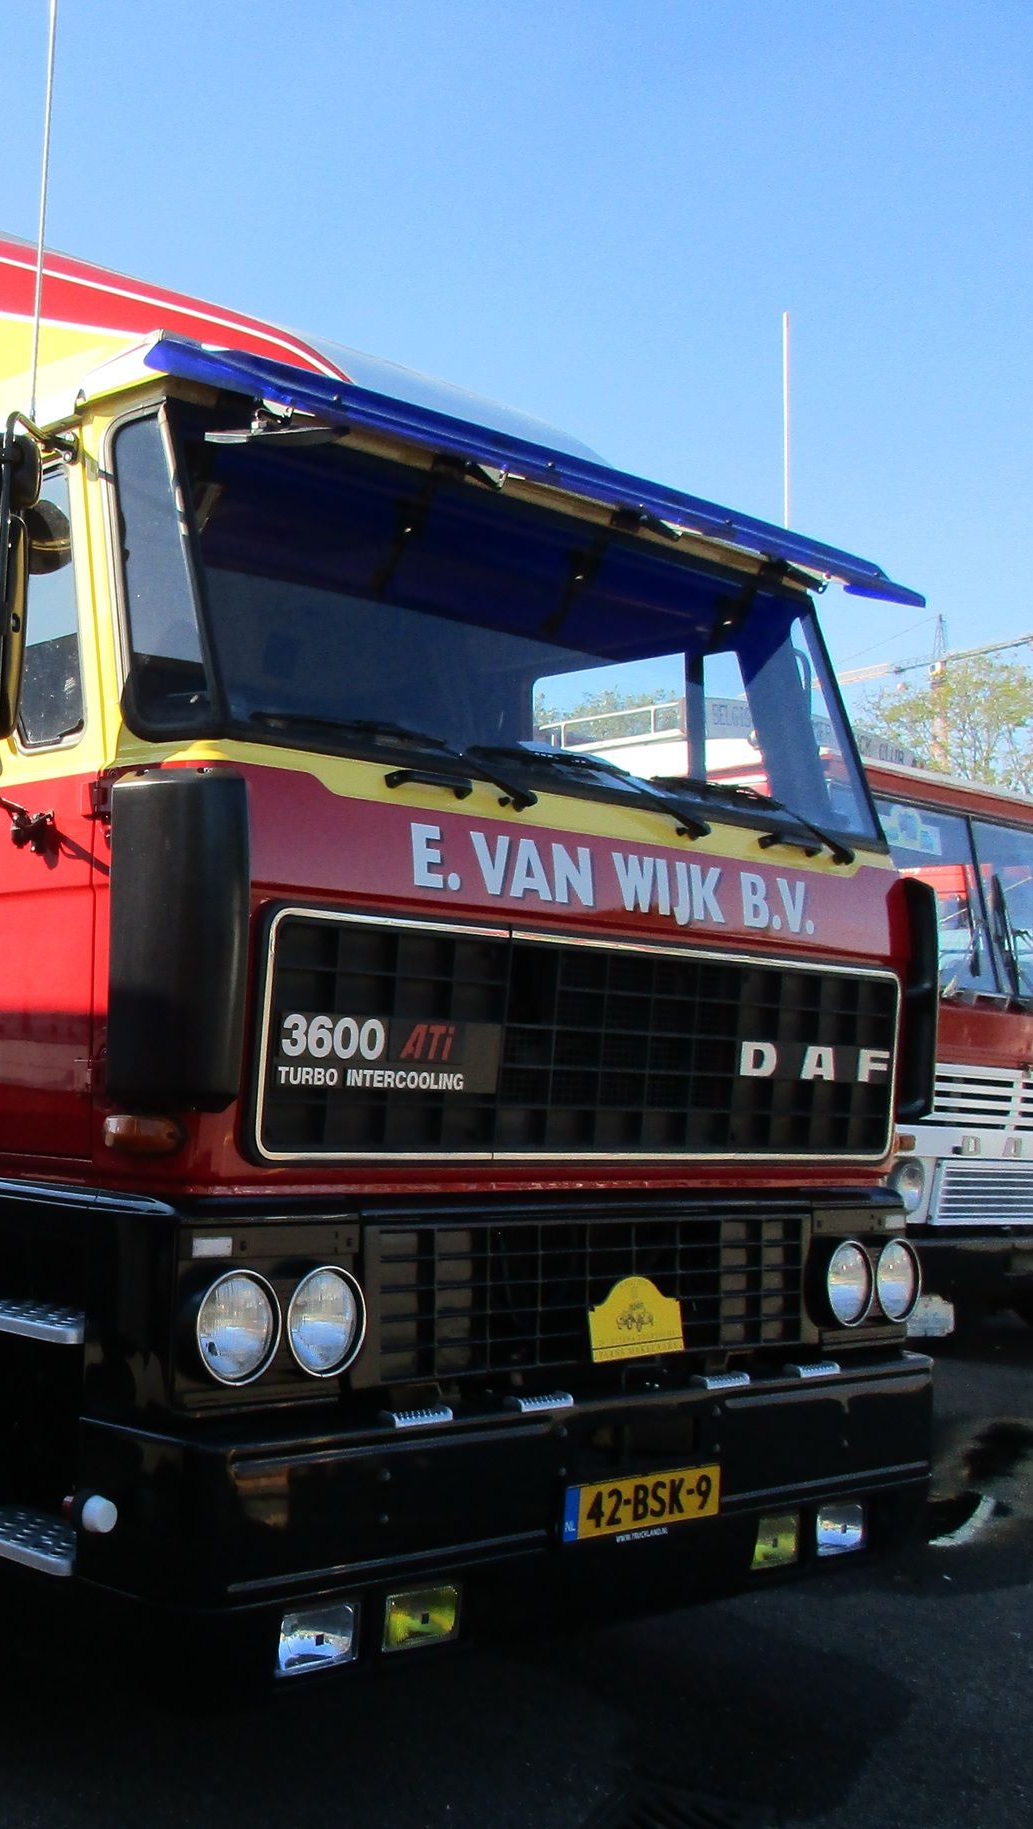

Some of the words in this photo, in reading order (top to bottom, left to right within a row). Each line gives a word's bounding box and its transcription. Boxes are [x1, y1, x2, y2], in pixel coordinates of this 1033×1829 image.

[410, 822, 462, 892] E.
[470, 830, 594, 907] VAN
[612, 851, 726, 926] WIJK
[740, 871, 815, 935] B.V.
[281, 1013, 386, 1061] 3600
[278, 1066, 338, 1086] TURBO
[346, 1068, 465, 1091] INTERCOOLING
[739, 1041, 891, 1083] DAF
[586, 1474, 712, 1528] 42-BSK-9
[565, 1521, 575, 1532] NL
